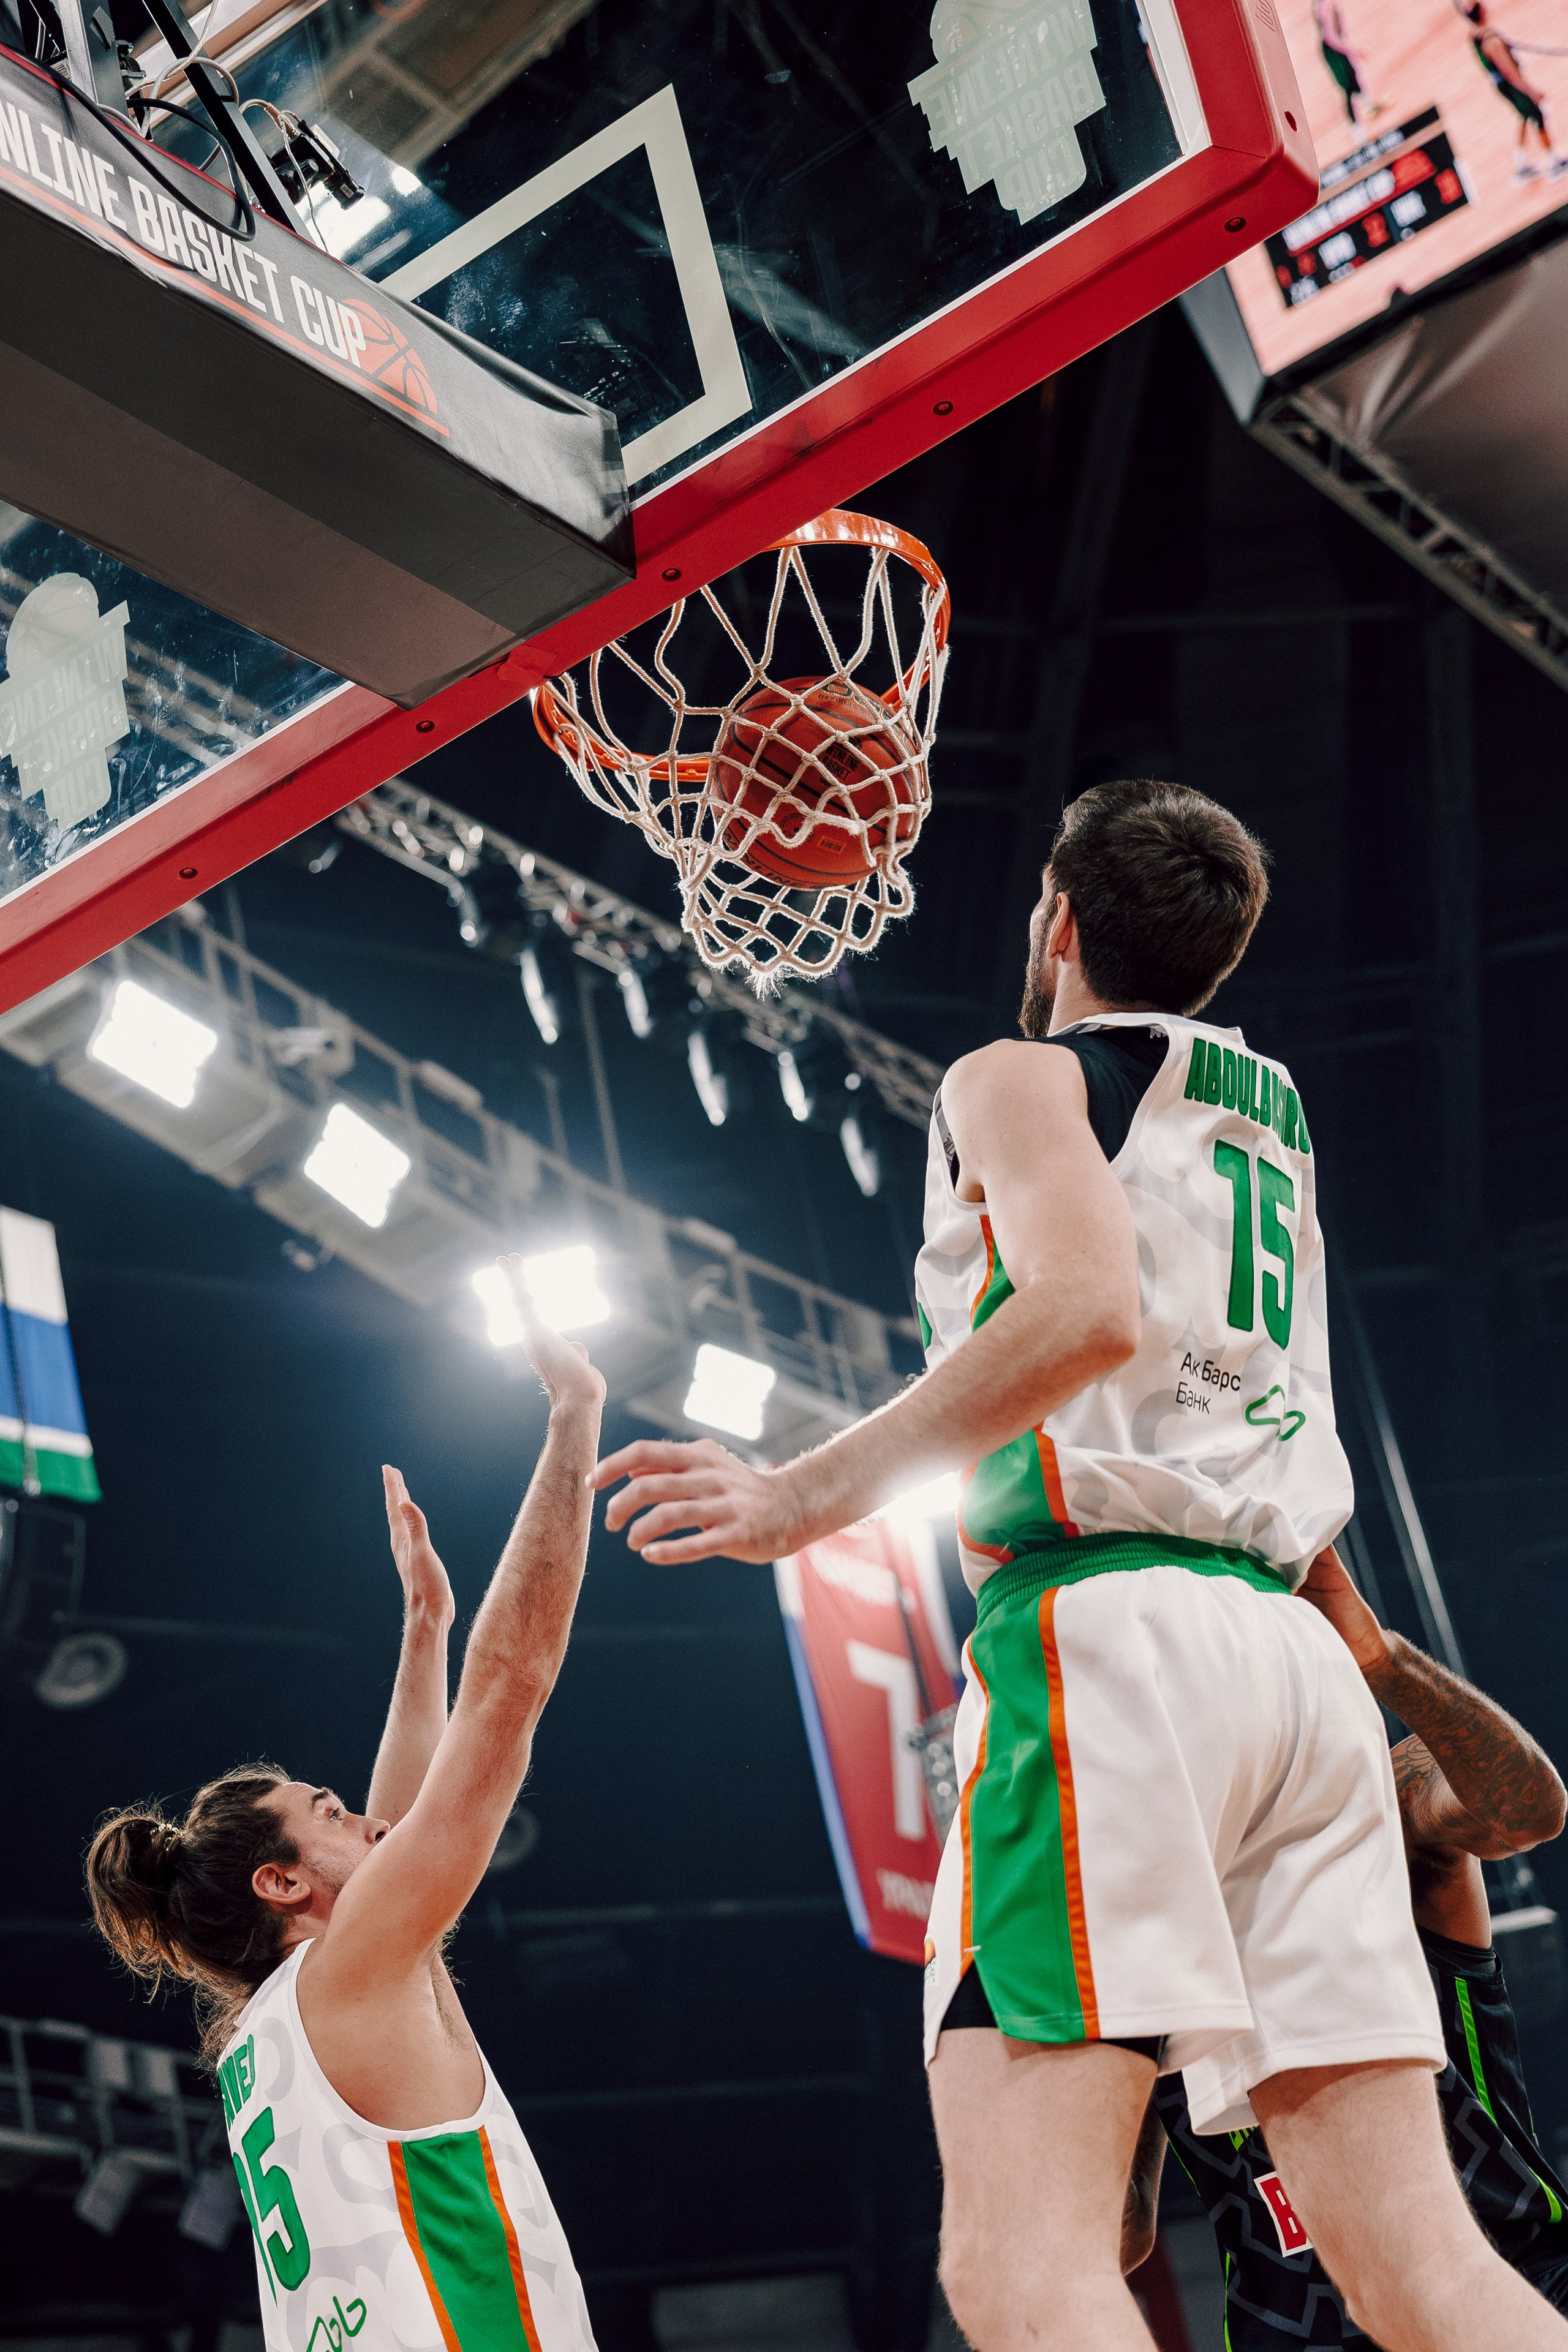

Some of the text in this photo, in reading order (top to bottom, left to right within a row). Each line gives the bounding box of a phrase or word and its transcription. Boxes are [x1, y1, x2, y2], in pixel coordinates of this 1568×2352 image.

[128, 176, 284, 324] BASKET
[290, 276, 366, 369] CUP
[1215, 1139, 1295, 1350] 15
[1176, 1381, 1210, 1414] Банк
[1180, 1352, 1241, 1392] Ак Барс
